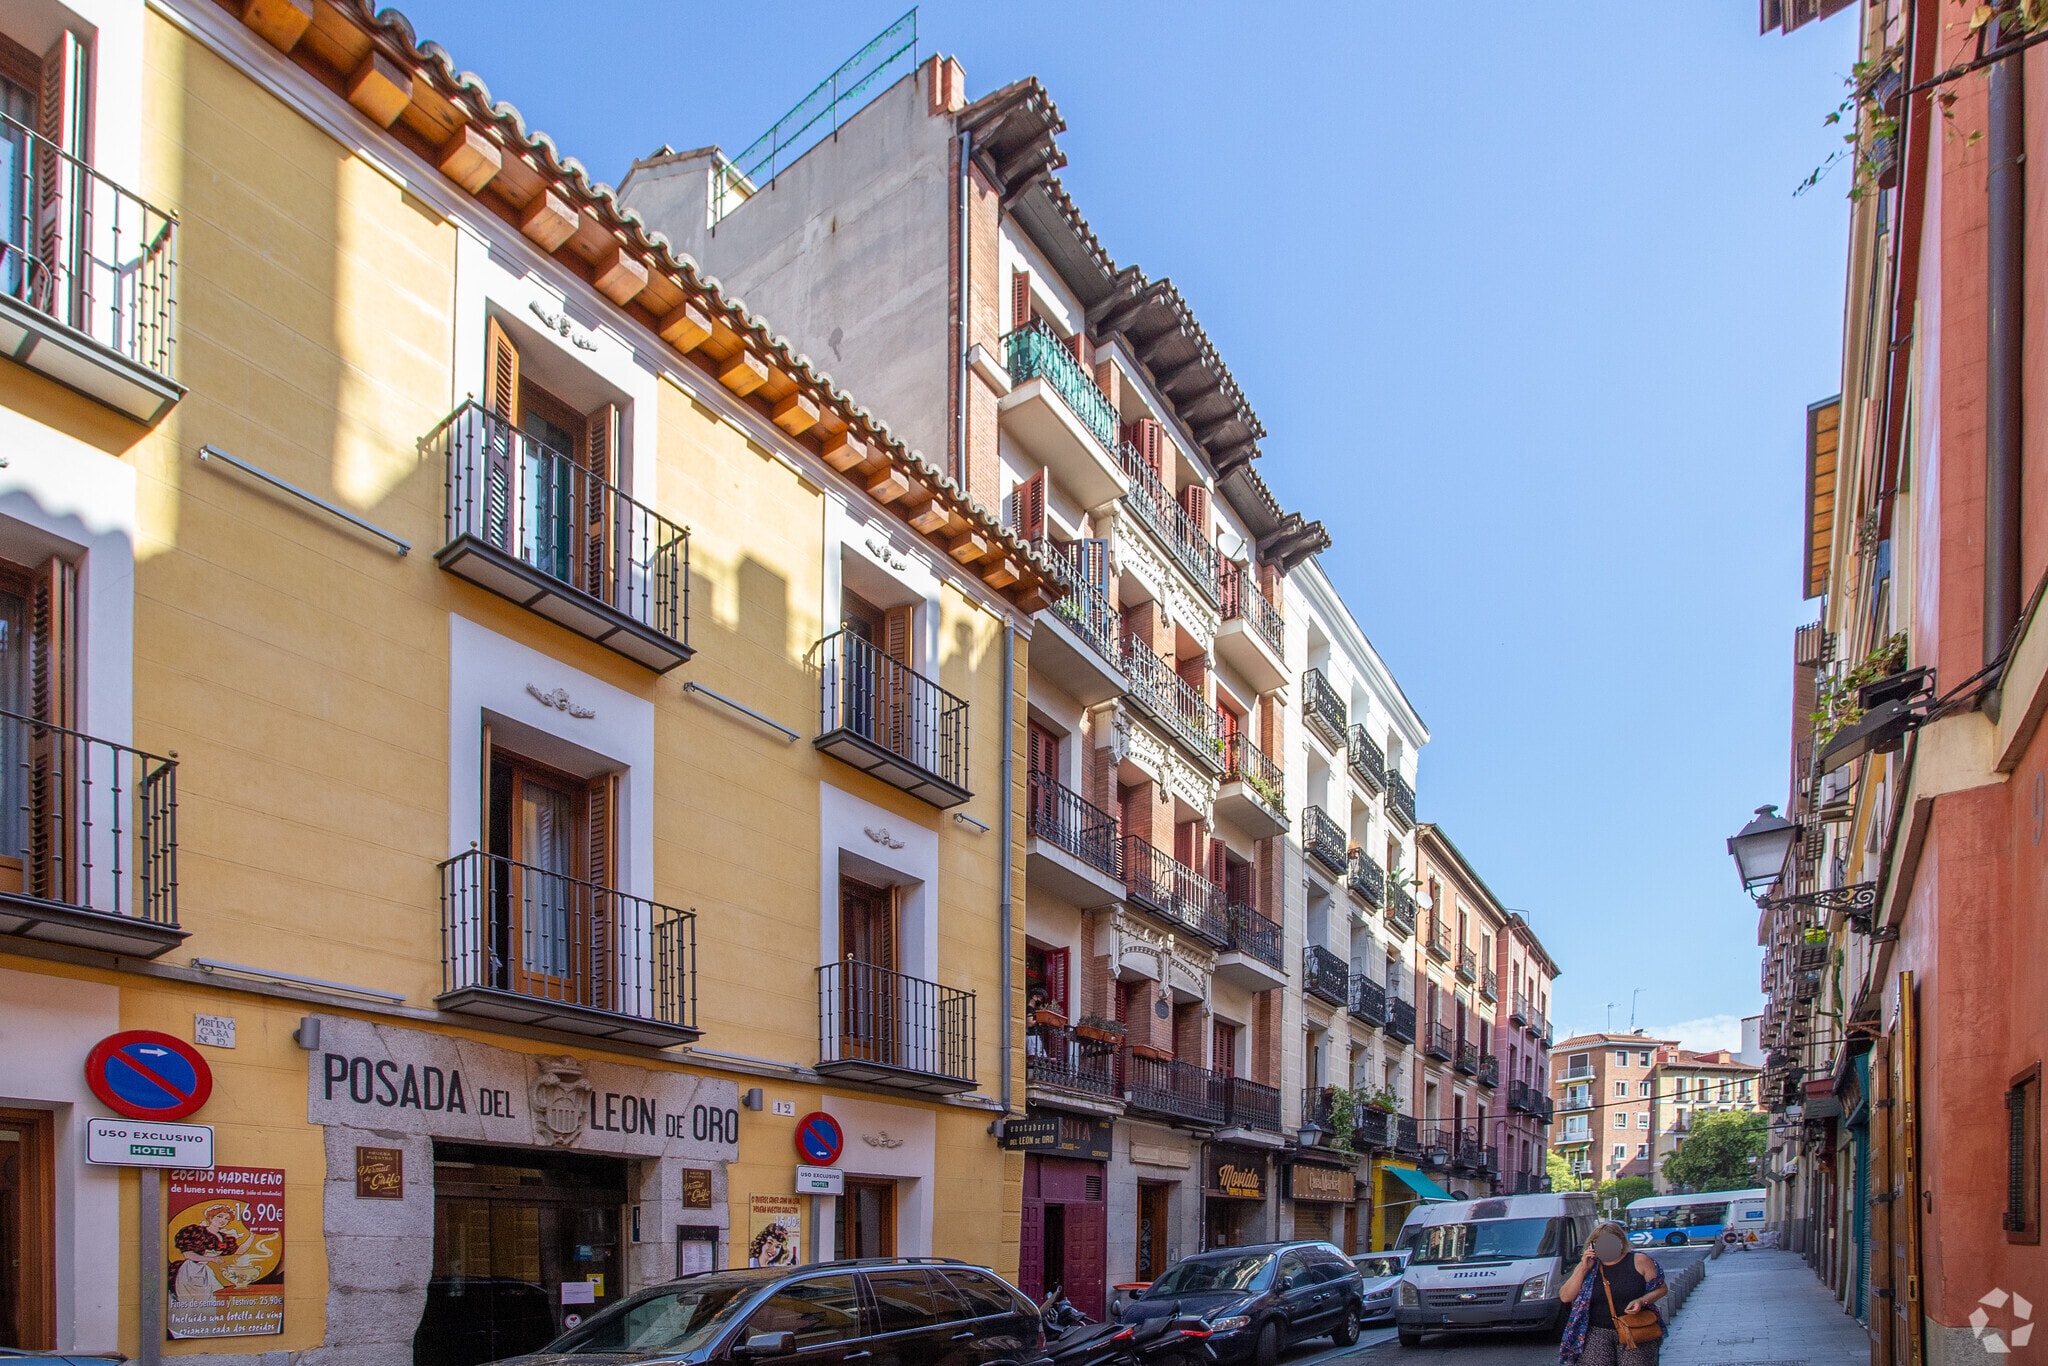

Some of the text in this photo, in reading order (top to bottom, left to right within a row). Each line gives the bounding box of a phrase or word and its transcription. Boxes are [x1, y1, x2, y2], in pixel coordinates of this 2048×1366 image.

[200, 1027, 230, 1039] CASA
[324, 1052, 739, 1145] POSADA DEL LEON DE ORO
[776, 1102, 791, 1114] 12
[1010, 1123, 1055, 1133] enotaberna
[98, 1129, 204, 1143] USO EXCLUSIVO
[1041, 1135, 1055, 1144] ORO
[132, 1146, 174, 1156] HOTEL
[171, 1169, 283, 1185] COCIDO MADRILEÑO
[1219, 1164, 1260, 1192] Movida
[170, 1184, 182, 1193] de
[184, 1185, 206, 1194] lunes
[216, 1186, 245, 1195] viernes
[235, 1202, 284, 1225] 16,90€
[170, 1299, 188, 1309] Fines
[189, 1299, 198, 1308] de
[199, 1300, 225, 1308] semana
[226, 1311, 253, 1321] botella
[255, 1311, 264, 1320] de
[266, 1311, 283, 1319] vino
[180, 1322, 275, 1335] crianza cada dos cocidos
